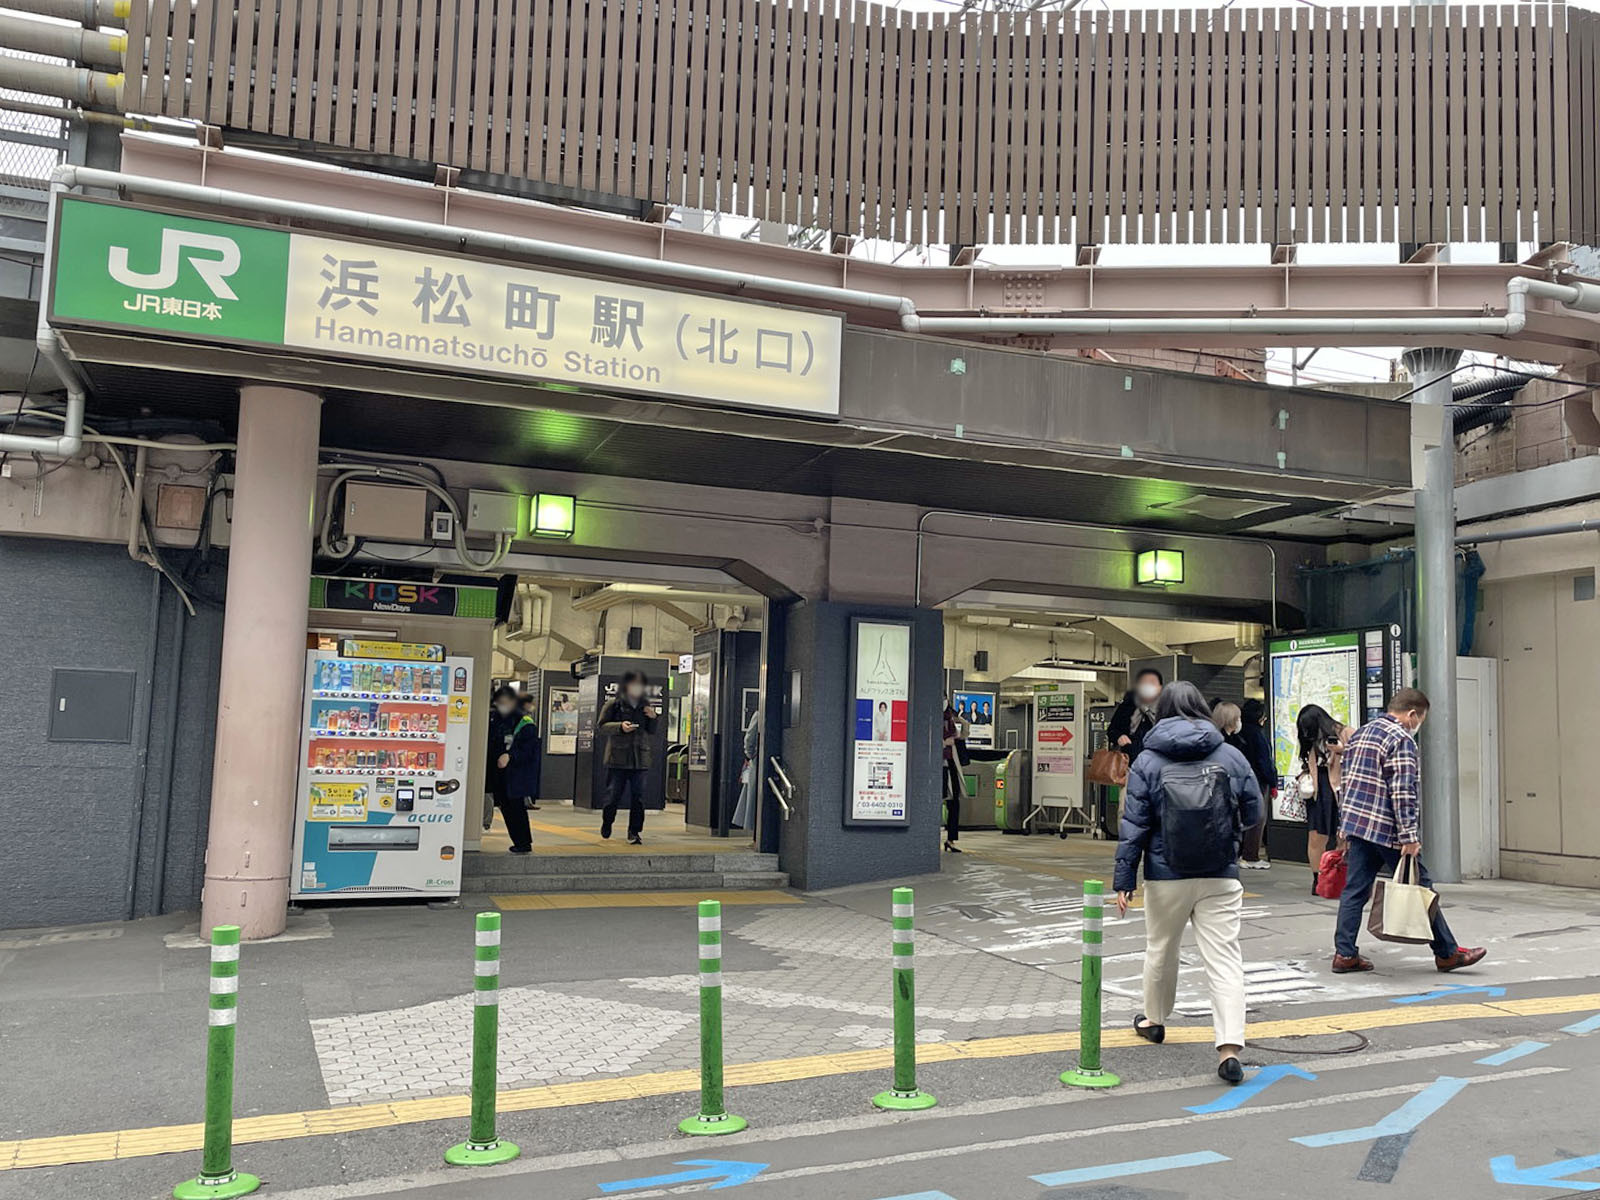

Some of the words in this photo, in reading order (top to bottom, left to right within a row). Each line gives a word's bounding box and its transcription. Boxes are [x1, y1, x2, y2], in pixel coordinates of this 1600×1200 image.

[108, 228, 241, 301] JR
[123, 294, 223, 321] JR東日本
[314, 316, 548, 369] Hamamatsuchō
[564, 351, 661, 384] Station
[344, 580, 439, 604] KIOSK
[373, 602, 411, 612] NewDays
[408, 813, 453, 823] acure
